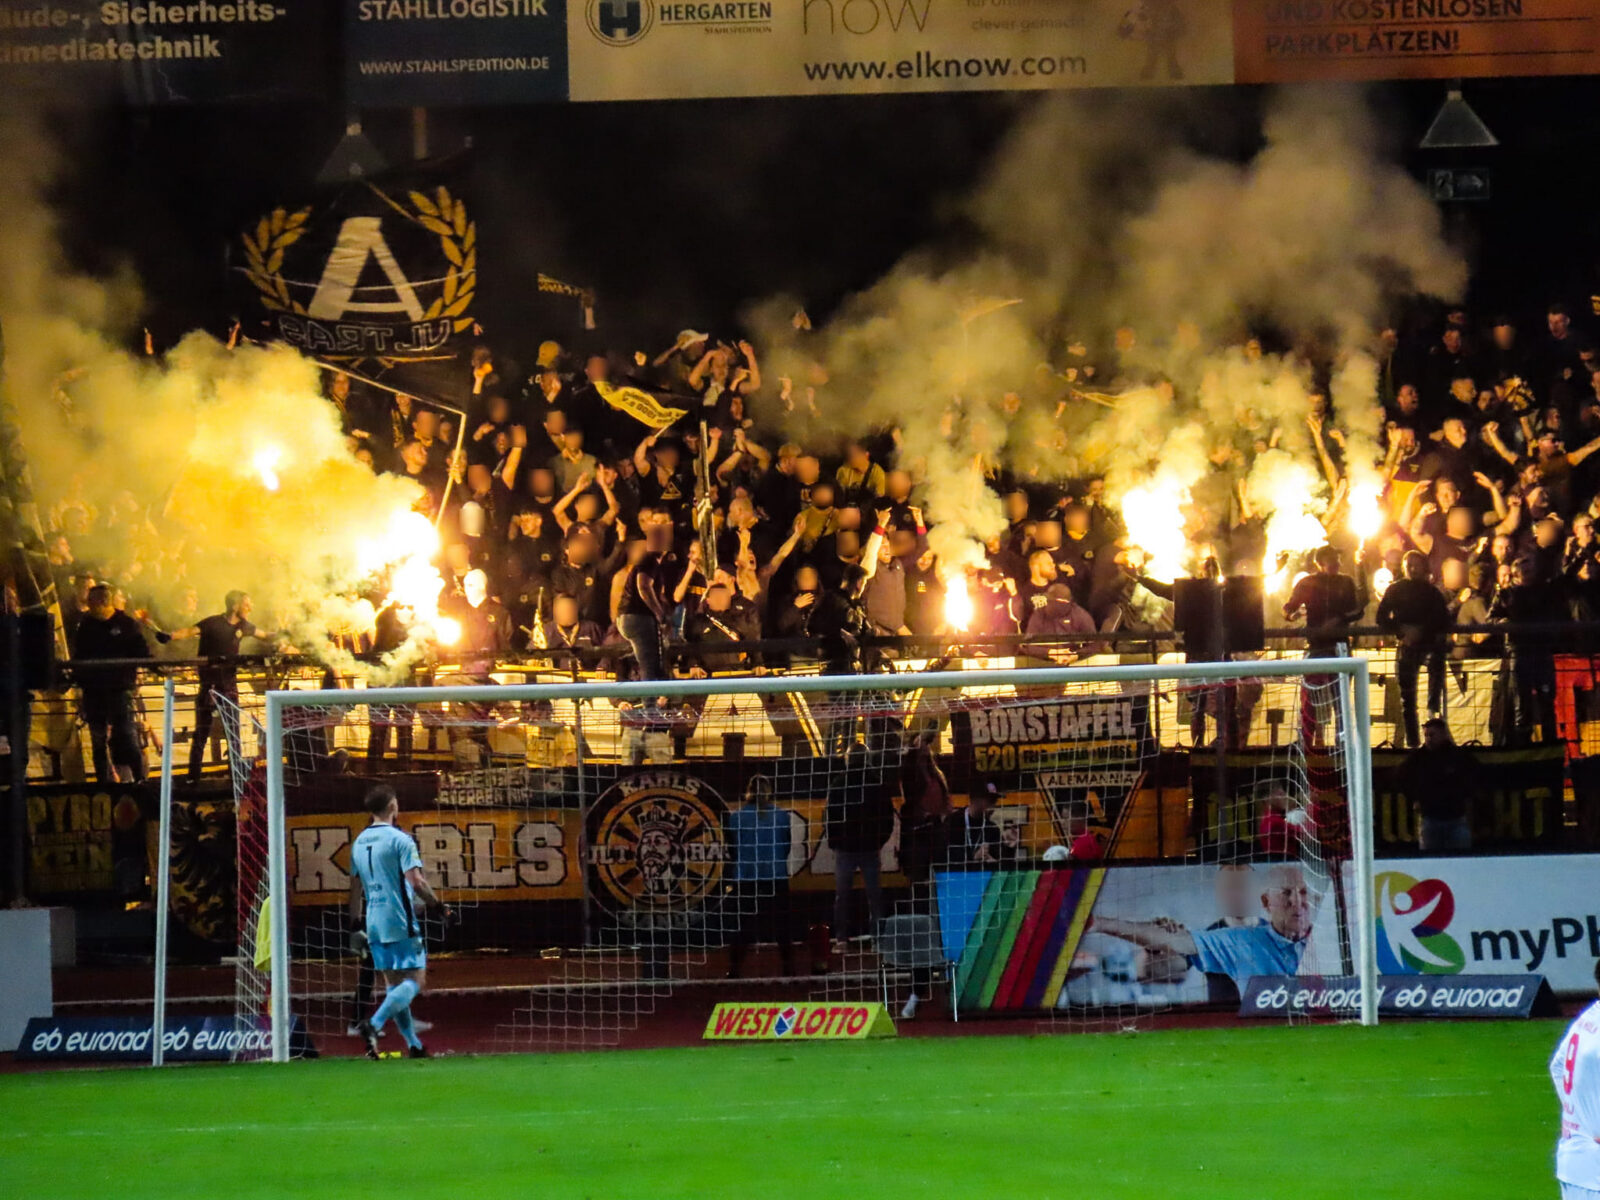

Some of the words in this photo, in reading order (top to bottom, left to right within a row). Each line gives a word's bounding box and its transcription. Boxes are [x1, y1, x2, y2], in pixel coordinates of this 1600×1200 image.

[101, 0, 286, 25] Sicherheits-
[358, 0, 548, 20] STAHLLOGISTIK
[660, 2, 771, 20] HERGARTEN
[1331, 0, 1522, 20] KOSTENLOSEN
[1265, 25, 1460, 53] PARKPLÄTZEN!
[359, 57, 549, 75] WWW.STAHLSPEDITION.DE
[804, 51, 1087, 80] www.elknow.com
[968, 702, 1137, 744] BOXSTAFFEL
[974, 744, 1016, 772] 520
[1047, 772, 1135, 786] ALEMANNIA
[292, 821, 568, 892] KRLS
[1293, 985, 1385, 1009] eurora
[1431, 984, 1525, 1008] eurorad
[713, 1007, 781, 1036] WEST
[791, 1007, 869, 1036] LOTTO
[65, 1028, 152, 1051] eurorad
[1562, 1033, 1580, 1096] 9
